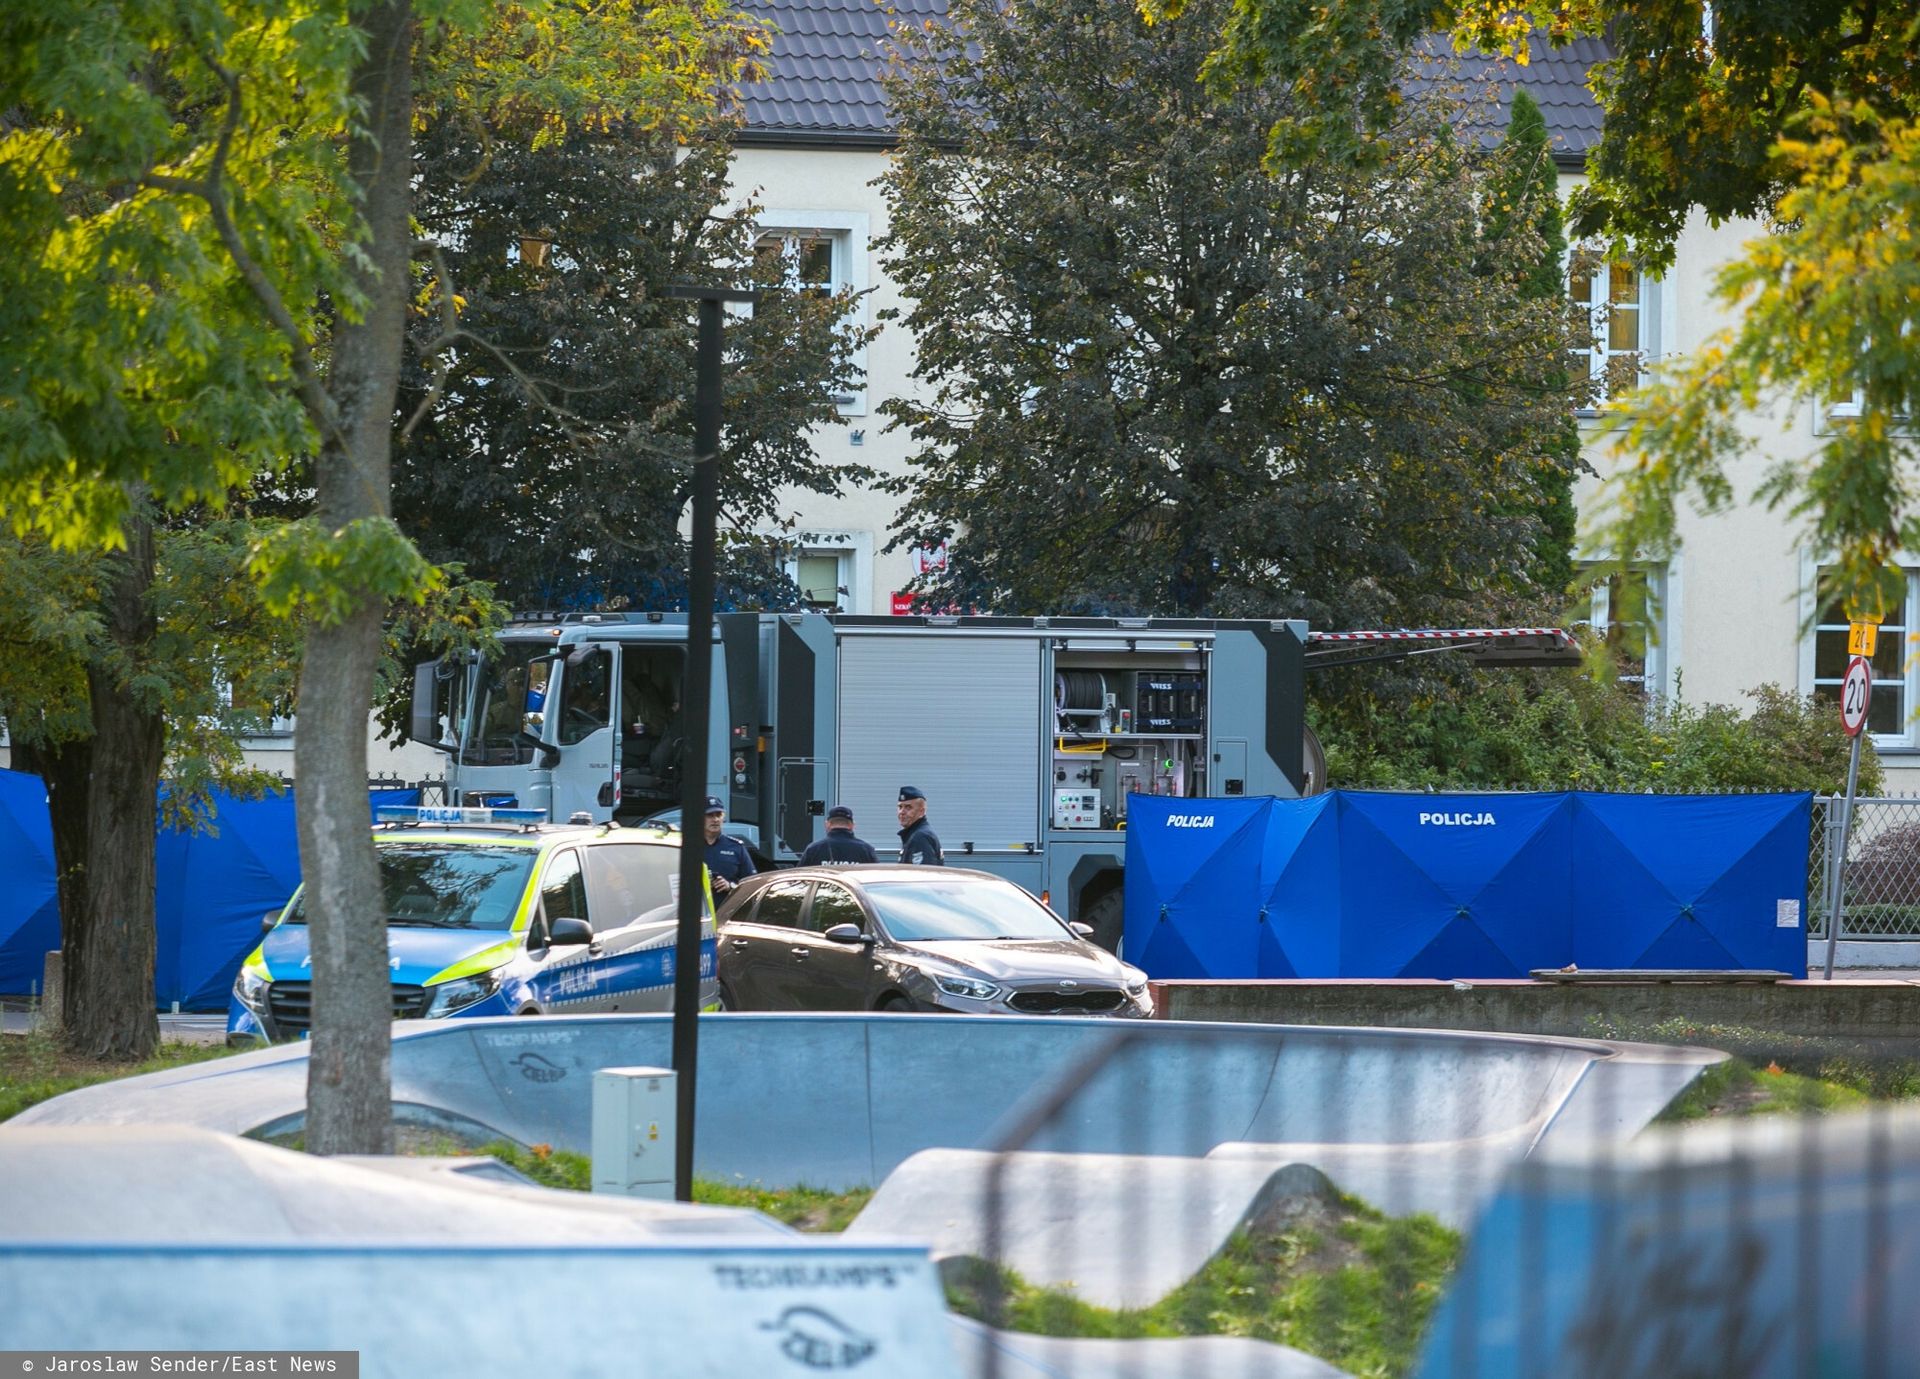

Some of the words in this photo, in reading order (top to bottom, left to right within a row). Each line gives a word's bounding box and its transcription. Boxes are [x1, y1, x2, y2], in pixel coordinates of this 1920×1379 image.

[1150, 682, 1172, 690] WISS
[1845, 678, 1866, 714] 20
[420, 809, 460, 821] POLICJA
[1166, 814, 1215, 828] POLICJA
[1419, 812, 1496, 826] POLICJA
[559, 966, 598, 995] POLICJA
